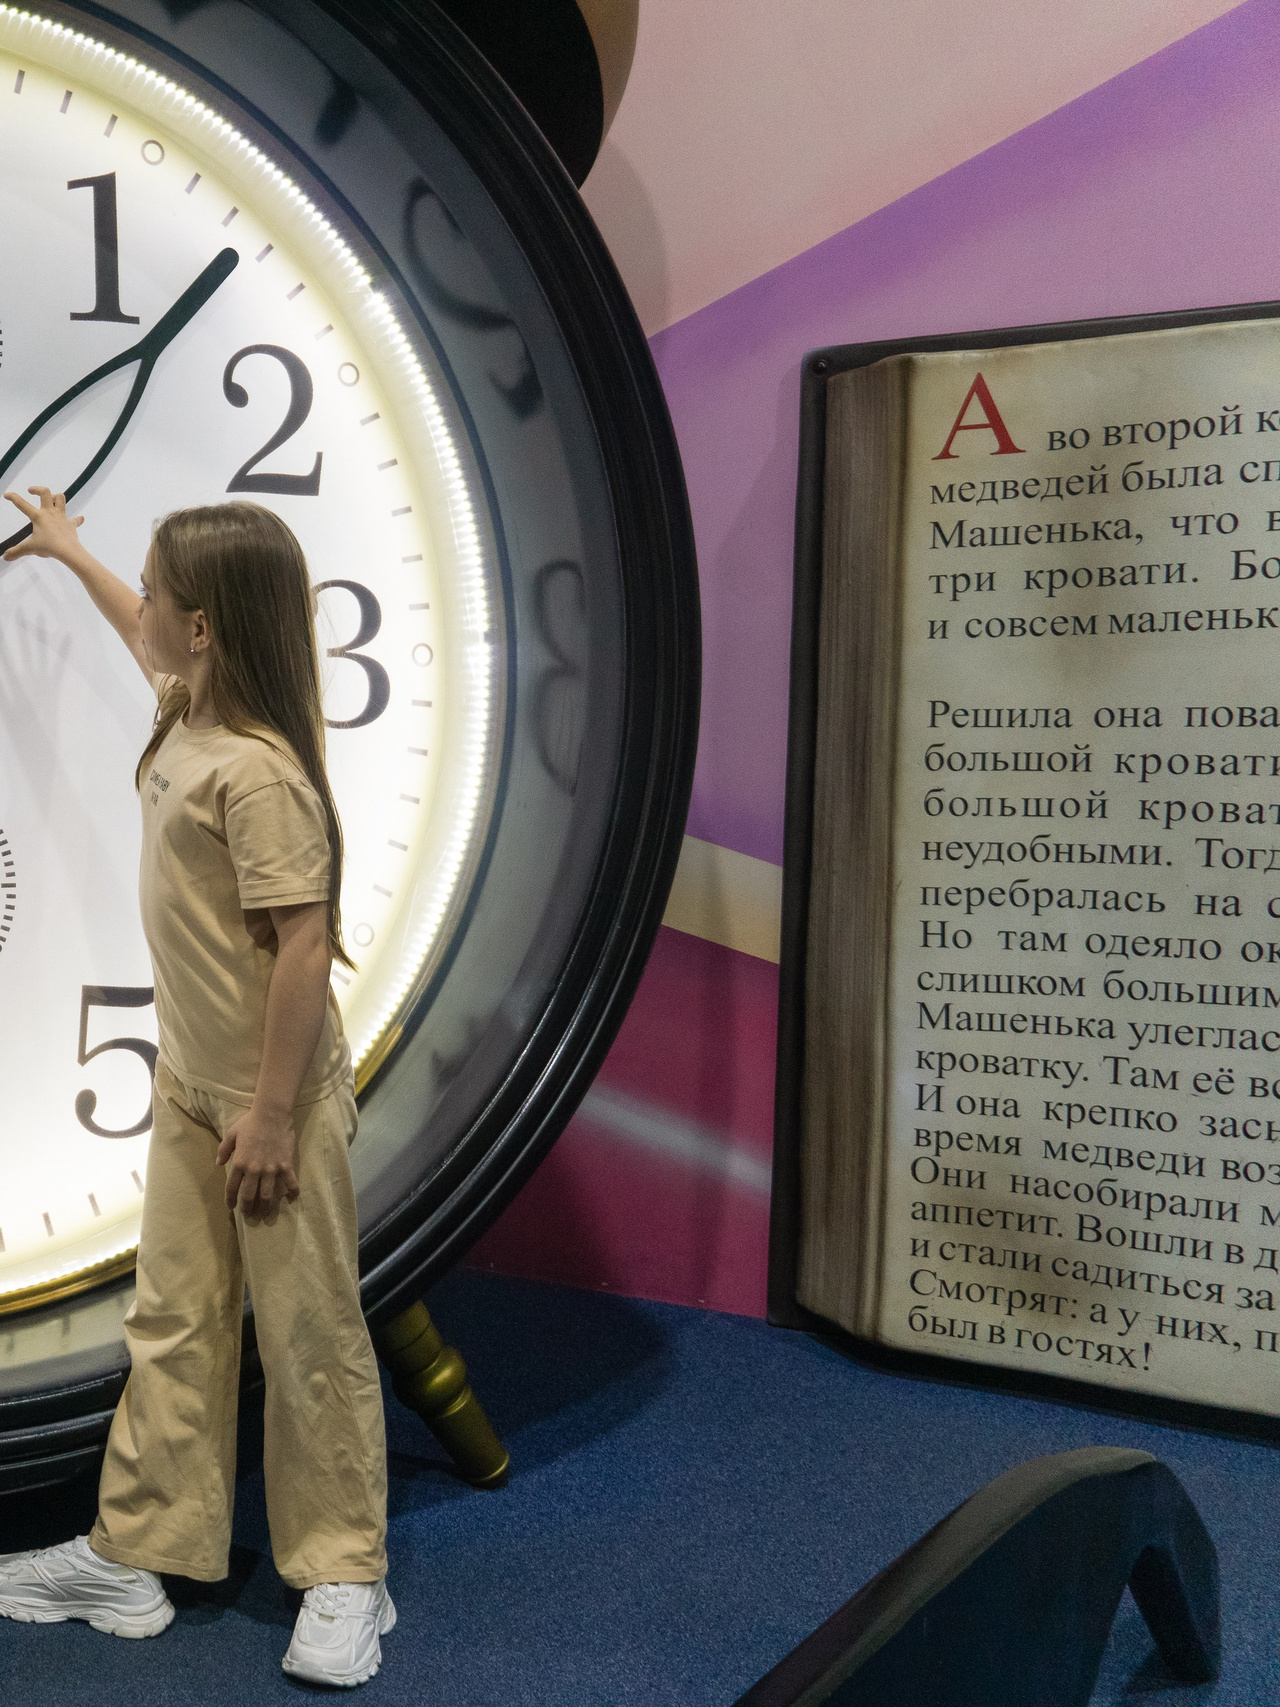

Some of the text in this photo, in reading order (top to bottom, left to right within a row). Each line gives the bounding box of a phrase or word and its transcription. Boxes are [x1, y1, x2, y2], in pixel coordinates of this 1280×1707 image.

[68, 172, 140, 325] 1
[223, 344, 322, 496] 2
[931, 372, 1280, 461] А во второй к
[930, 463, 1109, 505] медведей
[1121, 460, 1224, 493] была
[930, 518, 1144, 550] Машенька,
[1170, 512, 1240, 537] что
[928, 548, 1280, 603] три кровати. Бо
[928, 606, 1280, 640] и совсем маленьк
[311, 579, 391, 729] 3
[928, 699, 1280, 729] Решила она пова
[924, 742, 1093, 773] большой
[923, 787, 1108, 819] большой
[922, 833, 1173, 870] неудобными.
[921, 878, 1166, 917] перебралась
[1194, 894, 1243, 918] на
[920, 920, 973, 950] Но
[997, 930, 1067, 953] там
[1084, 933, 1223, 961] одеяло
[917, 971, 1085, 998] слишком
[917, 1001, 1280, 1053] Машенька улеглас
[75, 985, 158, 1139] 5
[916, 1050, 1089, 1090] кроватку.
[1102, 1055, 1179, 1091] Там
[1192, 1067, 1235, 1096] её
[917, 1083, 944, 1113] И
[956, 1095, 1021, 1119] она
[1044, 1100, 1178, 1133] крепко
[915, 1128, 1021, 1158] время
[1043, 1139, 1206, 1179] медведи
[910, 1156, 985, 1190] Они
[1010, 1174, 1239, 1224] насобирали
[911, 1202, 1279, 1275] аппетит. Вошли в д
[911, 1238, 1276, 1312] и стали садиться за
[909, 1268, 1279, 1353] Смотрят: а у них, п
[908, 1305, 1151, 1371] был в гостях!
